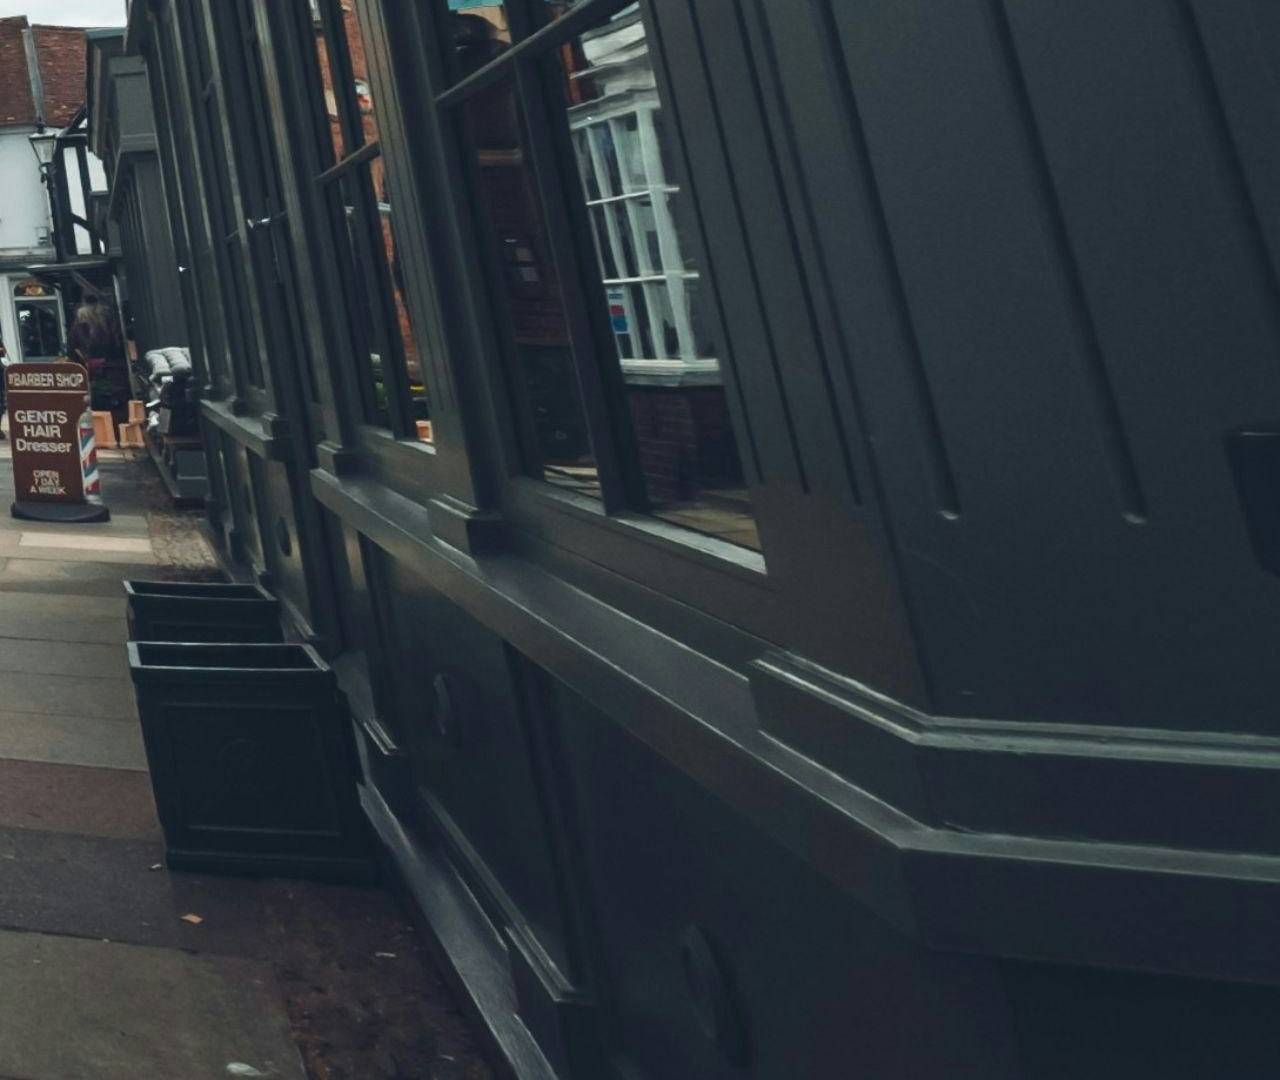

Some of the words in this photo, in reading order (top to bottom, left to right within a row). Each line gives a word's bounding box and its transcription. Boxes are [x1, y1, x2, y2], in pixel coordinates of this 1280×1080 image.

[13, 373, 54, 387] BARBER
[56, 373, 84, 388] SHOP
[14, 410, 68, 424] GENTS
[23, 424, 62, 439] HAIR
[15, 439, 72, 453] Dresser
[30, 485, 37, 494] A
